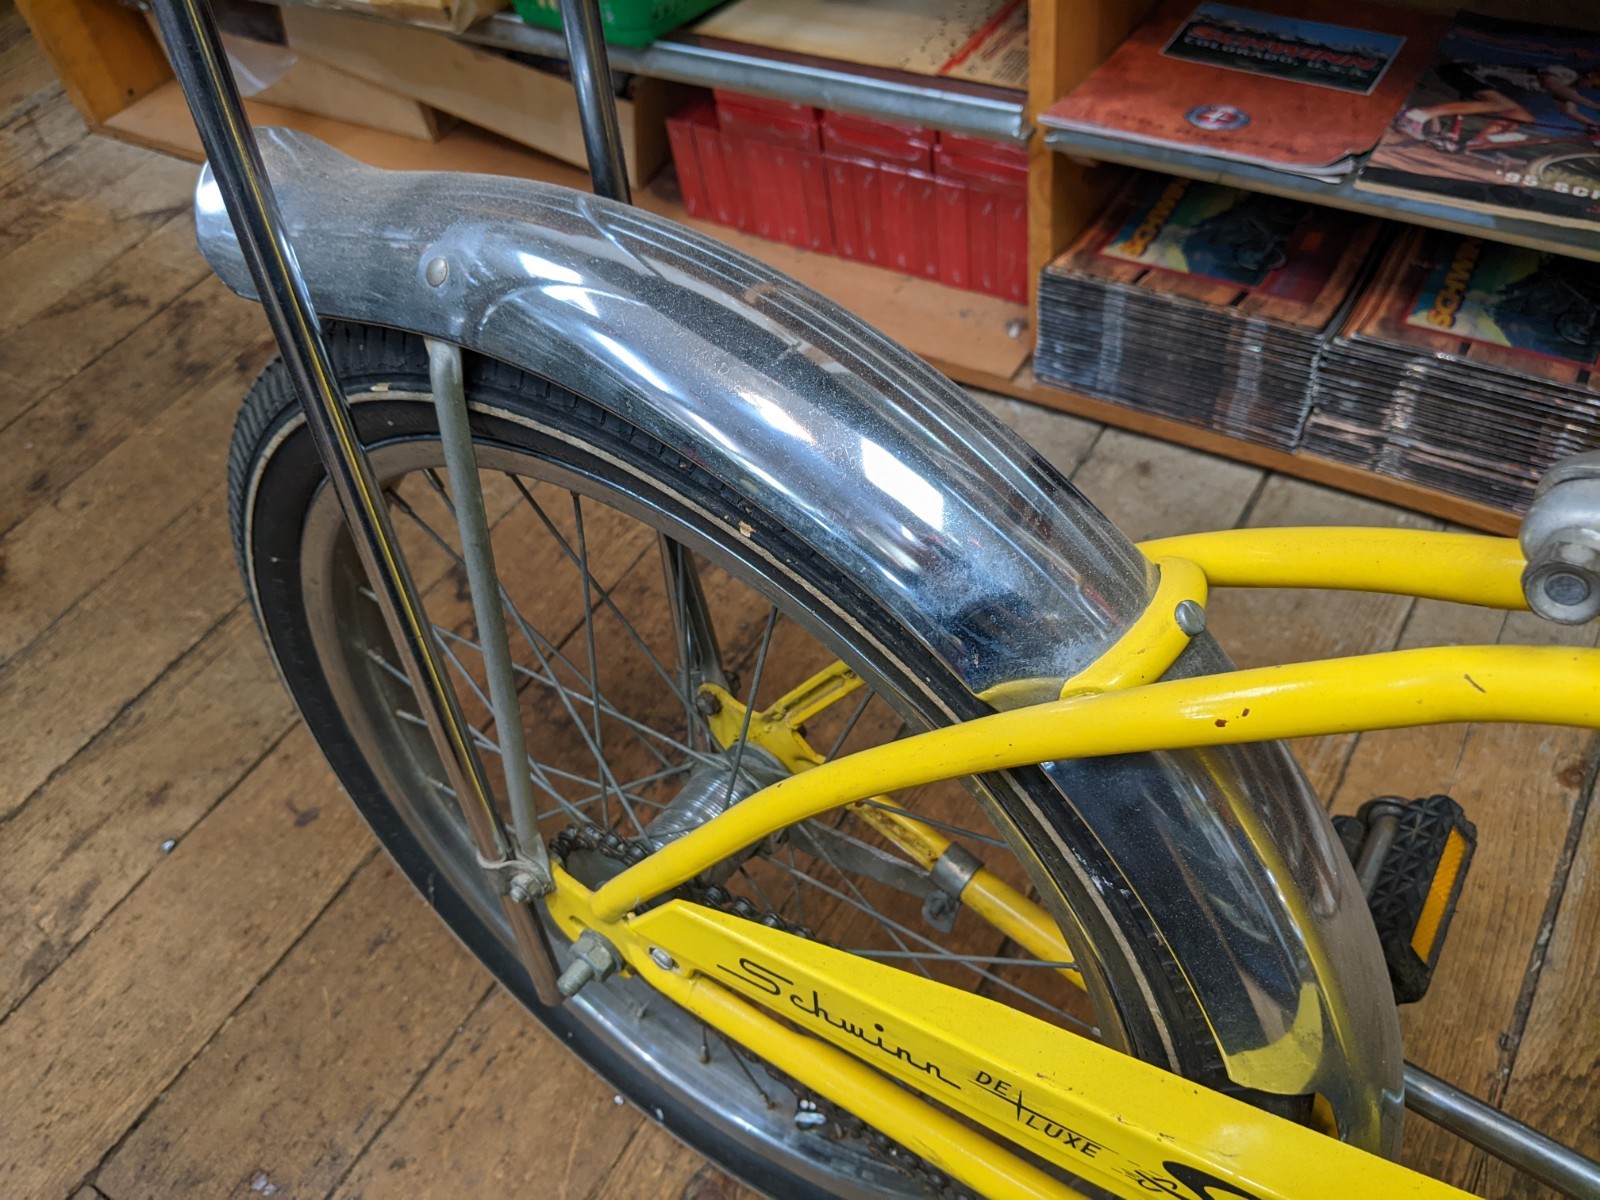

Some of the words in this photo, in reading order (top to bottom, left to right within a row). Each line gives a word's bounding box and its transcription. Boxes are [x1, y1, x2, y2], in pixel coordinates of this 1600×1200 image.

[717, 957, 962, 1090] Schwinn
[975, 1069, 1012, 1096] DE
[1025, 1115, 1102, 1159] LUXE
